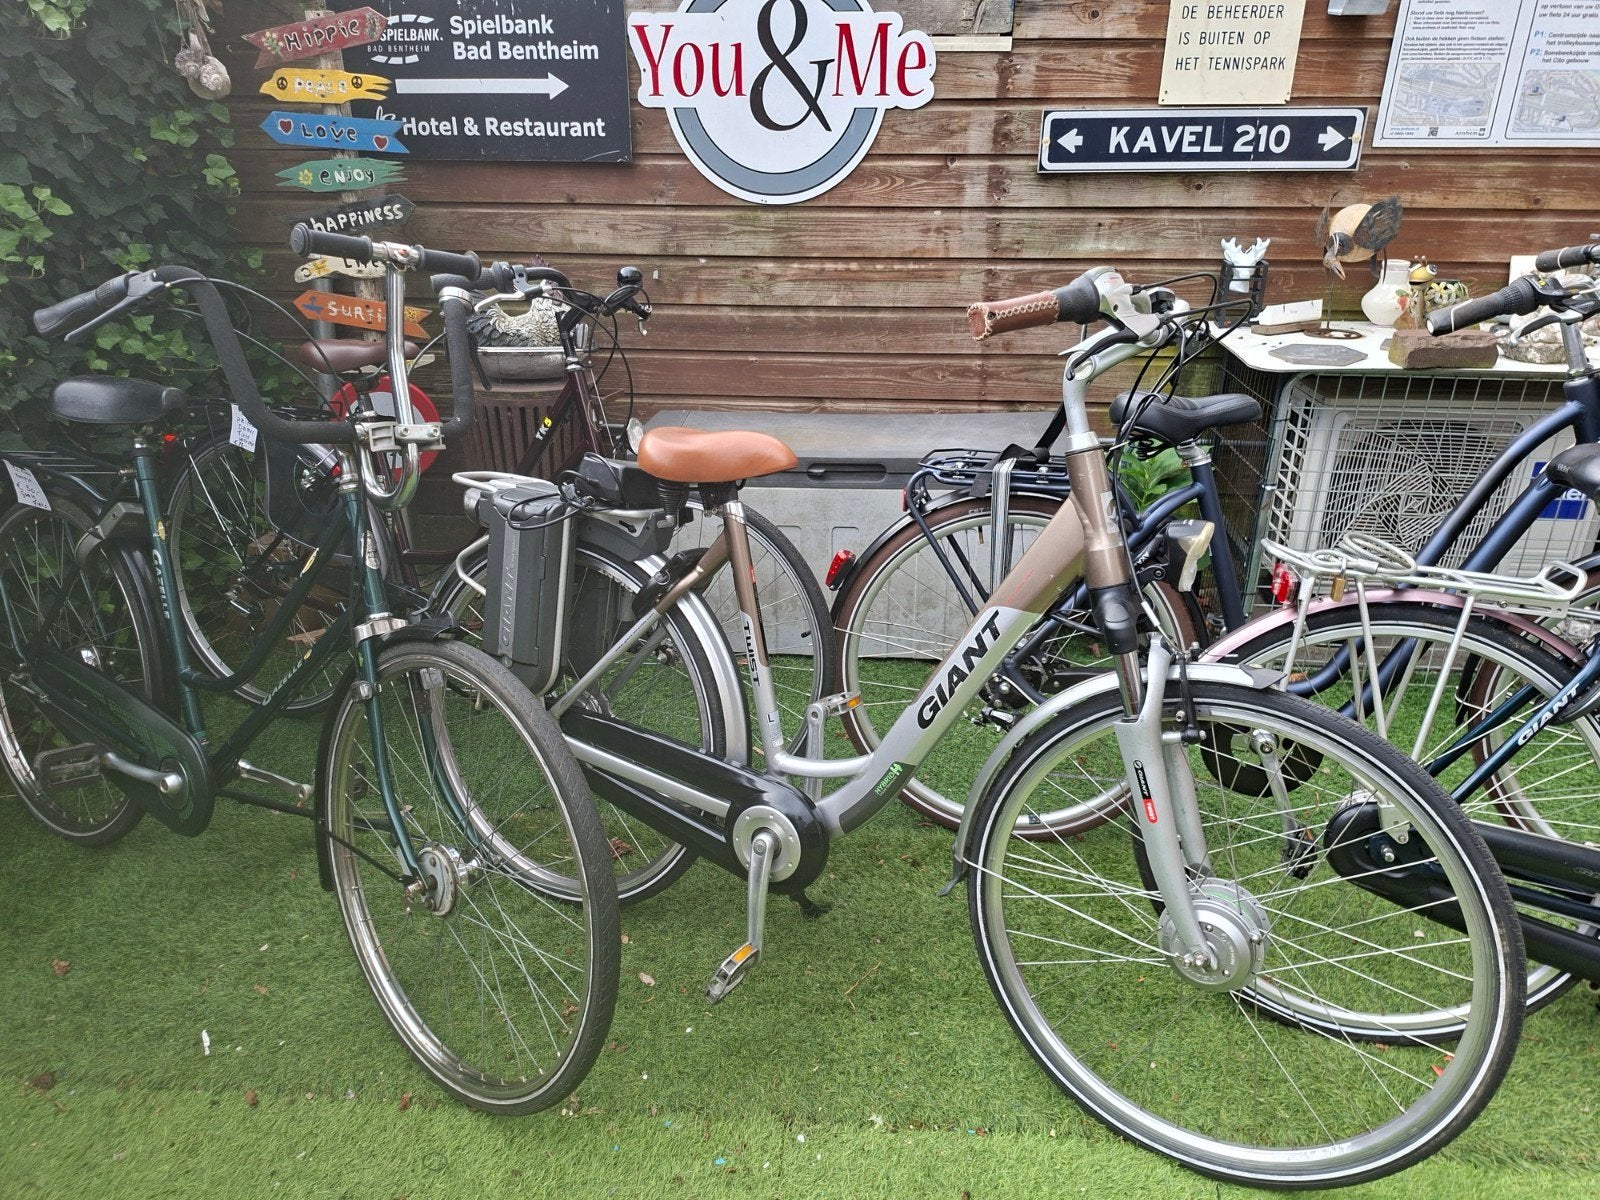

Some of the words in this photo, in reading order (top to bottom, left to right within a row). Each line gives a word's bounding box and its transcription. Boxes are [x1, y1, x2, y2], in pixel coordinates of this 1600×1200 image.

[1182, 5, 1198, 19] DE
[1207, 5, 1285, 19] BEHEERDER
[450, 14, 554, 39] Spielbank
[1178, 31, 1190, 45] IS
[1200, 31, 1245, 45] BUITEN
[1253, 31, 1271, 45] OP
[367, 45, 383, 53] BAD
[388, 45, 430, 53] BENTHEIM
[452, 42, 492, 60] Bad
[498, 40, 599, 60] Bentheim
[632, 24, 747, 97] You
[832, 23, 927, 97] Me
[1175, 57, 1199, 71] HET
[1208, 57, 1287, 71] TENNISPARK
[402, 116, 458, 136] Hotel
[464, 117, 480, 136] &
[485, 117, 606, 137] Restaurant
[1108, 126, 1223, 153] KAVEL
[1233, 124, 1291, 153] 210
[743, 620, 761, 687] TWIST
[917, 609, 1001, 730] GIANT
[1517, 682, 1580, 747] GIANT
[874, 770, 895, 797] HYBRID
[1137, 769, 1149, 797] GIANT
